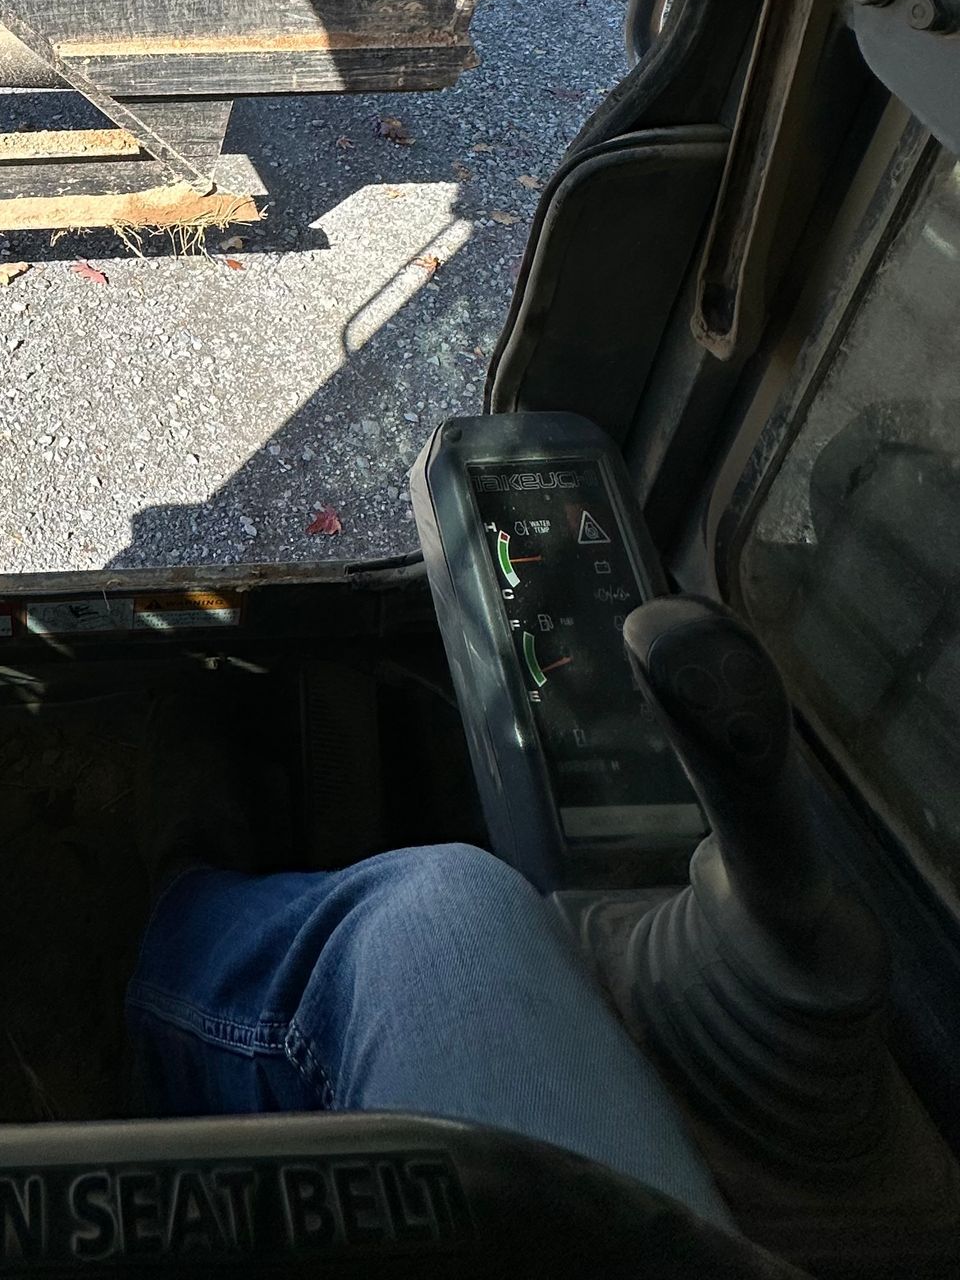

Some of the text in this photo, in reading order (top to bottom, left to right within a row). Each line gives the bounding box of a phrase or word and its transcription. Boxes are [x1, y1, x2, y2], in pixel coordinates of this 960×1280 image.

[483, 521, 498, 533] H
[528, 519, 551, 527] WATER
[533, 526, 551, 534] TEMP
[68, 1163, 266, 1263] SEAT
[279, 1158, 480, 1251] BELT
